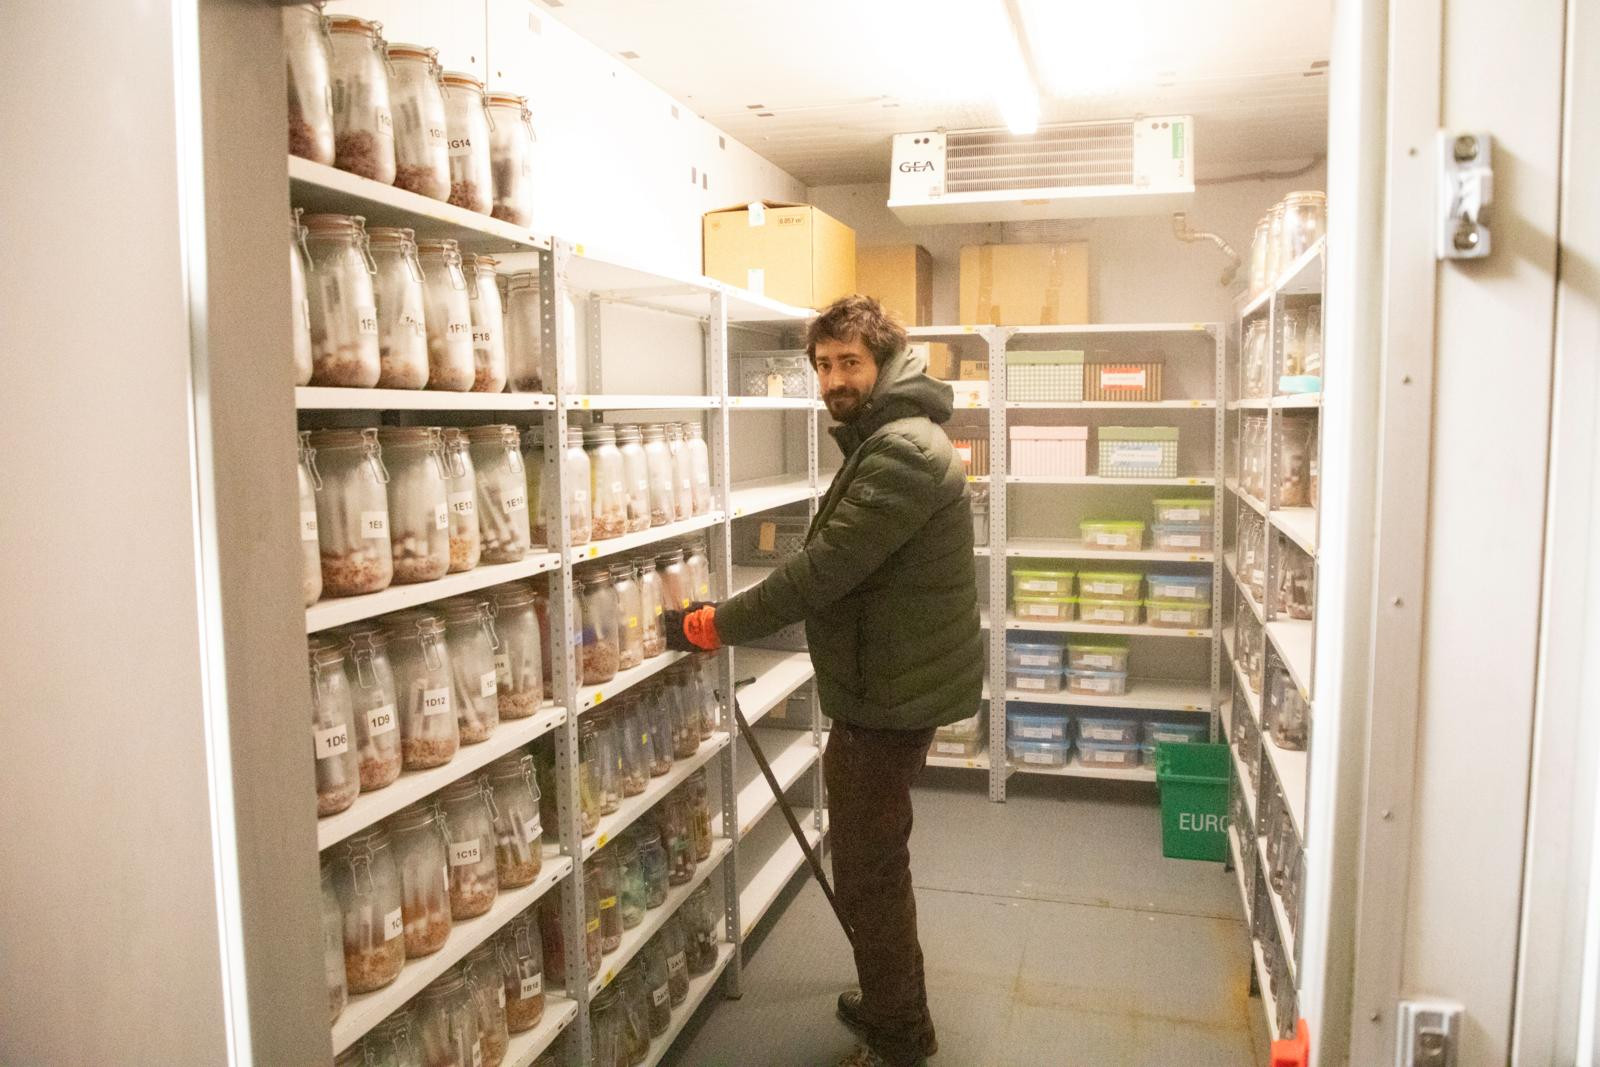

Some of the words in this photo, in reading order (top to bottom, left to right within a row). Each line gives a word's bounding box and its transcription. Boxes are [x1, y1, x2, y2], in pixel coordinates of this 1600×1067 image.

[899, 160, 935, 173] GEA
[371, 714, 390, 728] 1D9
[326, 733, 347, 748] 1D6
